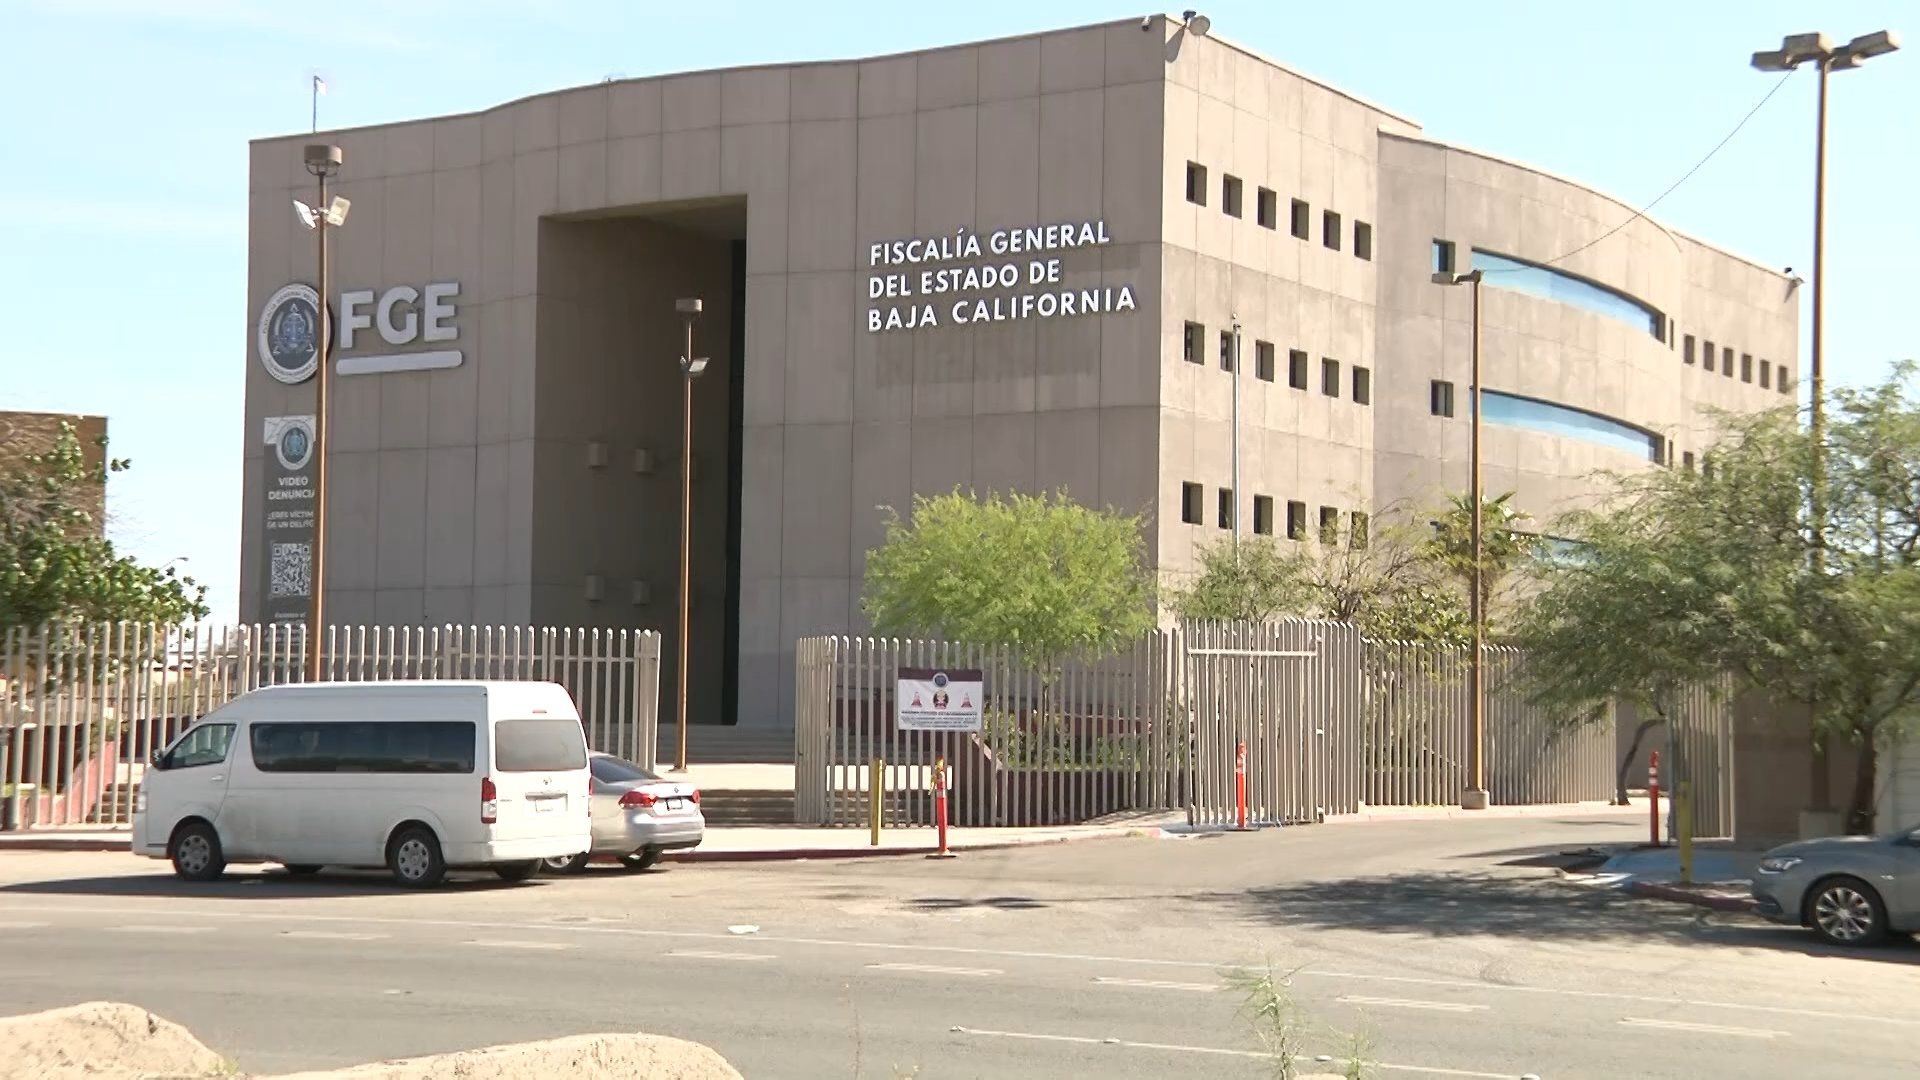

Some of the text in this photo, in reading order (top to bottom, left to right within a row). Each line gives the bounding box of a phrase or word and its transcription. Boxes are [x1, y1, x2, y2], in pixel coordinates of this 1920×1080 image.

[870, 221, 1110, 266] FISCALÍA GENERAL
[869, 259, 1060, 299] DEL ESTADO DE
[340, 282, 459, 348] FGE
[868, 287, 1136, 332] BAJA CALIFORNIA
[278, 476, 308, 486] VIDEO
